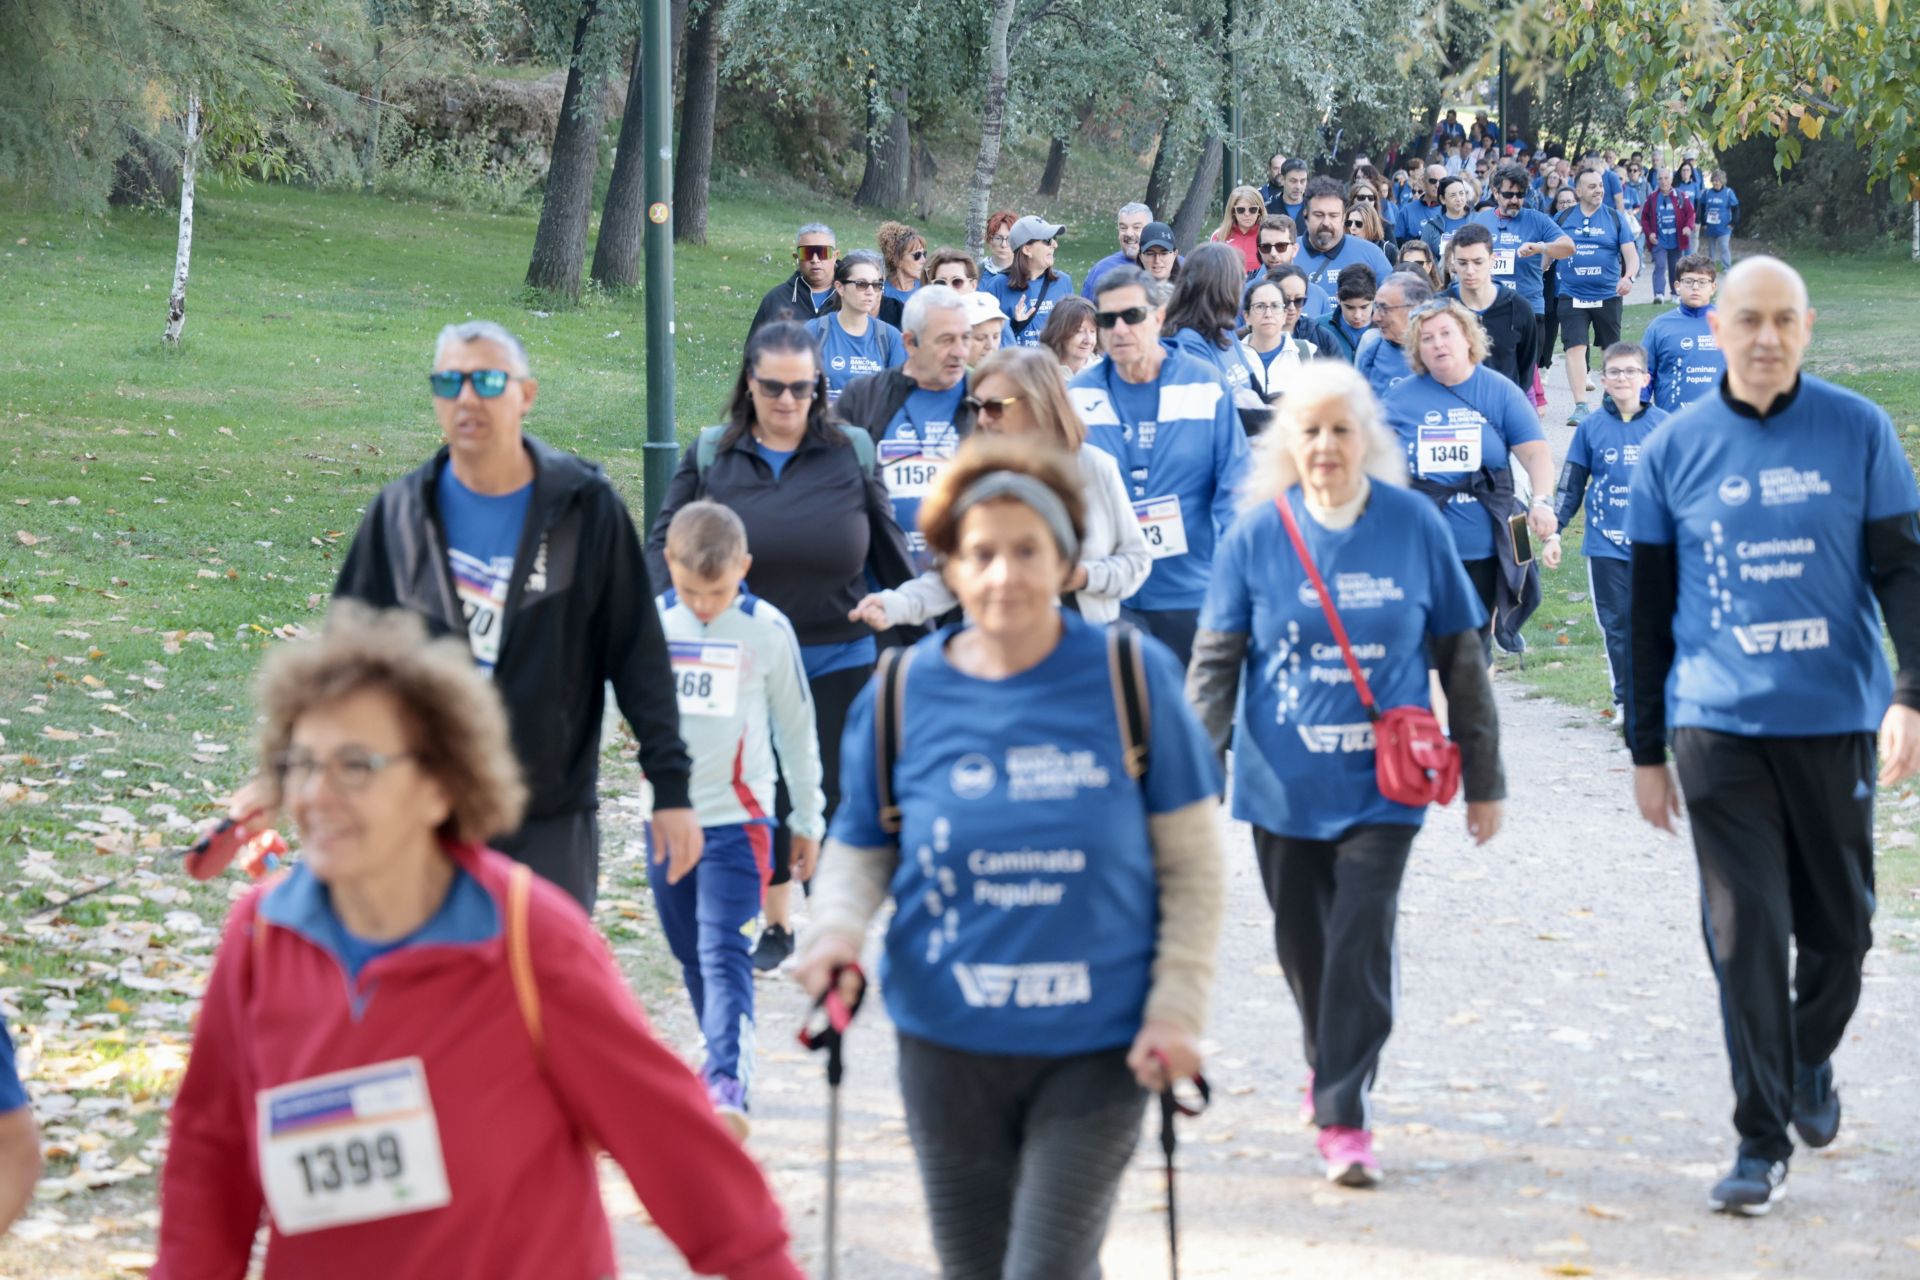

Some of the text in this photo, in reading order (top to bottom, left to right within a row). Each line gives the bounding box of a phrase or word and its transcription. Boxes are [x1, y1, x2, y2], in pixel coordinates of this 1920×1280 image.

[1686, 376, 1712, 384] Popular
[1430, 445, 1469, 462] 1346
[895, 465, 937, 485] 1158
[1736, 537, 1816, 560] Caminata
[1740, 560, 1805, 585] Popular
[677, 671, 713, 698] 68
[968, 849, 1087, 876] Caminata
[973, 879, 1067, 912] Popular
[296, 1131, 404, 1195] 1399
